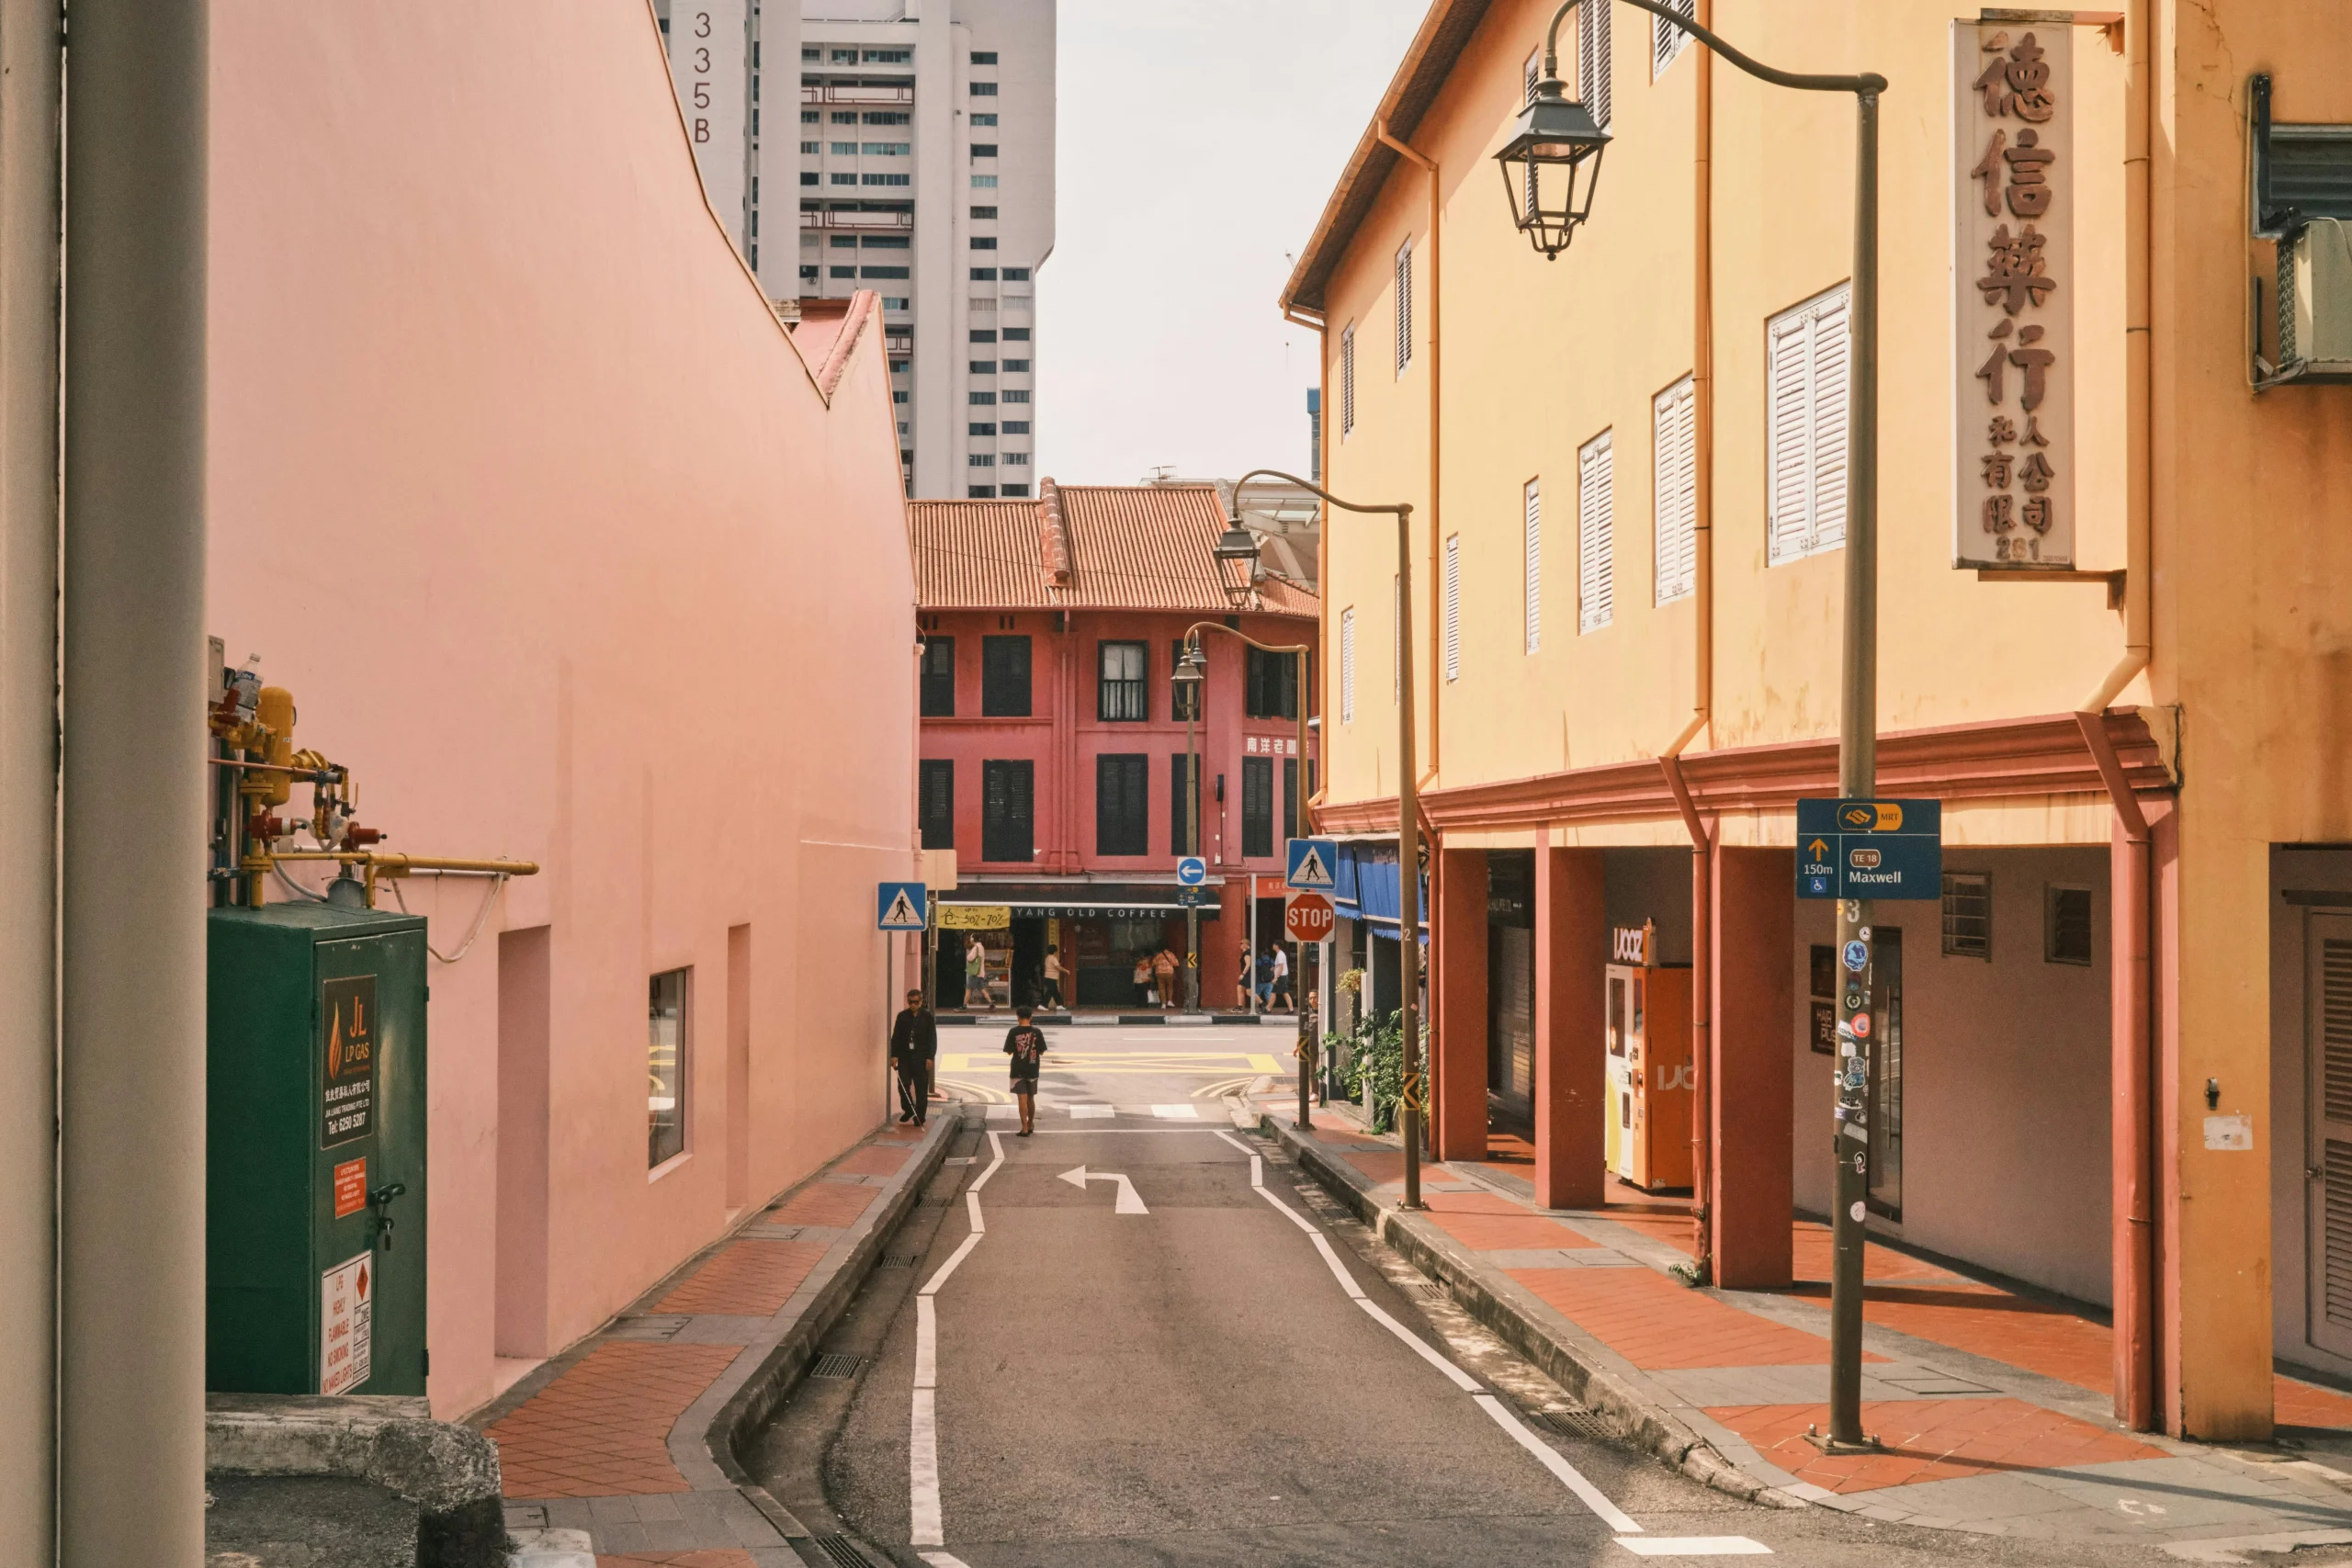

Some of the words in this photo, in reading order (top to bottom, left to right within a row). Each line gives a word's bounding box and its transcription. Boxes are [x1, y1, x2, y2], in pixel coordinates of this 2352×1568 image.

[695, 12, 711, 143] 335B
[1247, 737, 1309, 753] 南洋老咖
[1881, 813, 1899, 821] MRT
[1853, 854, 1864, 863] TE
[1867, 854, 1877, 863] 18
[1804, 864, 1833, 874] 150m
[1849, 872, 1901, 884] Maxwell
[1067, 908, 1095, 917] OLD
[1107, 909, 1167, 918] COFFEE
[1288, 908, 1332, 928] STOP
[1847, 899, 1860, 923] 3
[1404, 928, 1411, 942] 2
[349, 996, 367, 1038] JL
[345, 1044, 355, 1063] LP
[355, 1042, 369, 1061] GAS
[342, 1102, 356, 1113] TRADING
[328, 1120, 338, 1135] Tel:
[339, 1115, 352, 1132] 6250
[353, 1111, 366, 1128] 5287
[329, 1318, 349, 1343] FLAMMABLE
[327, 1352, 333, 1367] NO
[334, 1343, 349, 1365] SMOKING
[323, 1378, 329, 1394] NO
[329, 1371, 340, 1390] NAKED
[341, 1363, 353, 1385] LIGHTS
